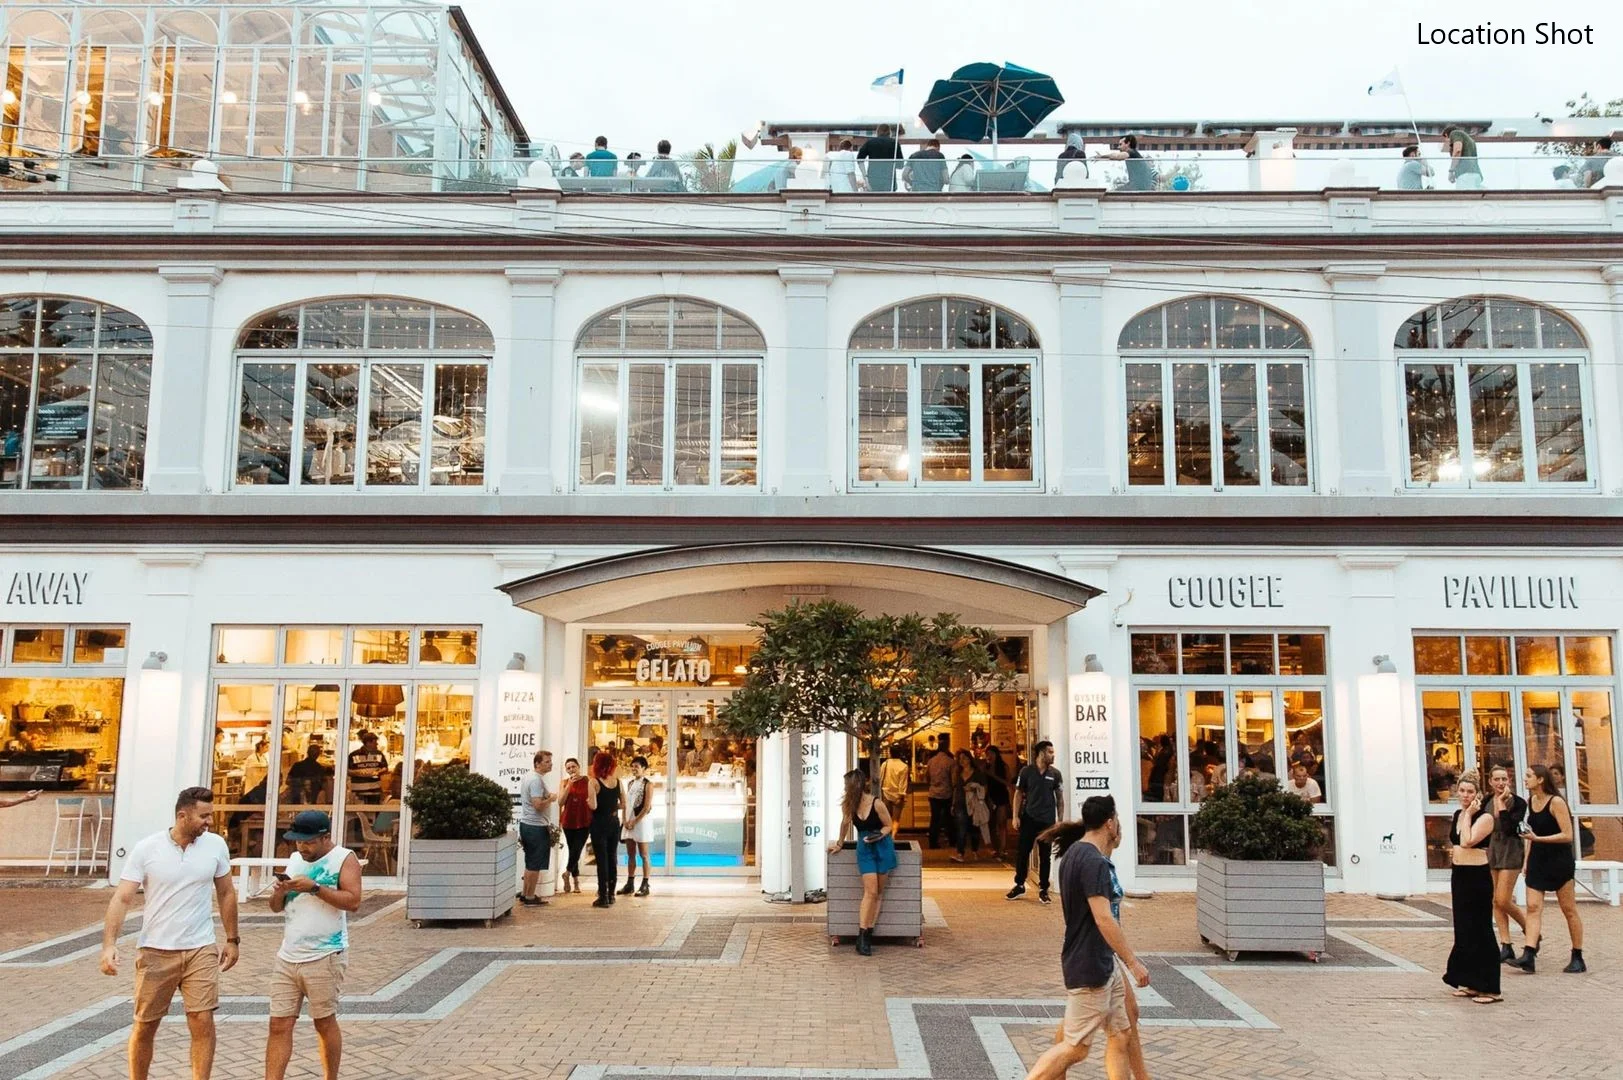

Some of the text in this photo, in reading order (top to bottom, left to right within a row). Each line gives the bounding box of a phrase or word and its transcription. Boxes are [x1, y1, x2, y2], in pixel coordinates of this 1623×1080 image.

[6, 571, 92, 605] AWAY
[1168, 575, 1580, 609] COOGEE PAVILION
[646, 640, 672, 651] COOGEE
[636, 658, 711, 682] GELATO
[503, 691, 535, 702] PIZZA
[1074, 694, 1107, 703] OYSTER
[1075, 704, 1107, 722] BAR
[503, 733, 536, 747] JUICE
[1074, 751, 1110, 765] GRILL
[499, 767, 531, 777] PING PON
[1078, 778, 1108, 789] GAMES
